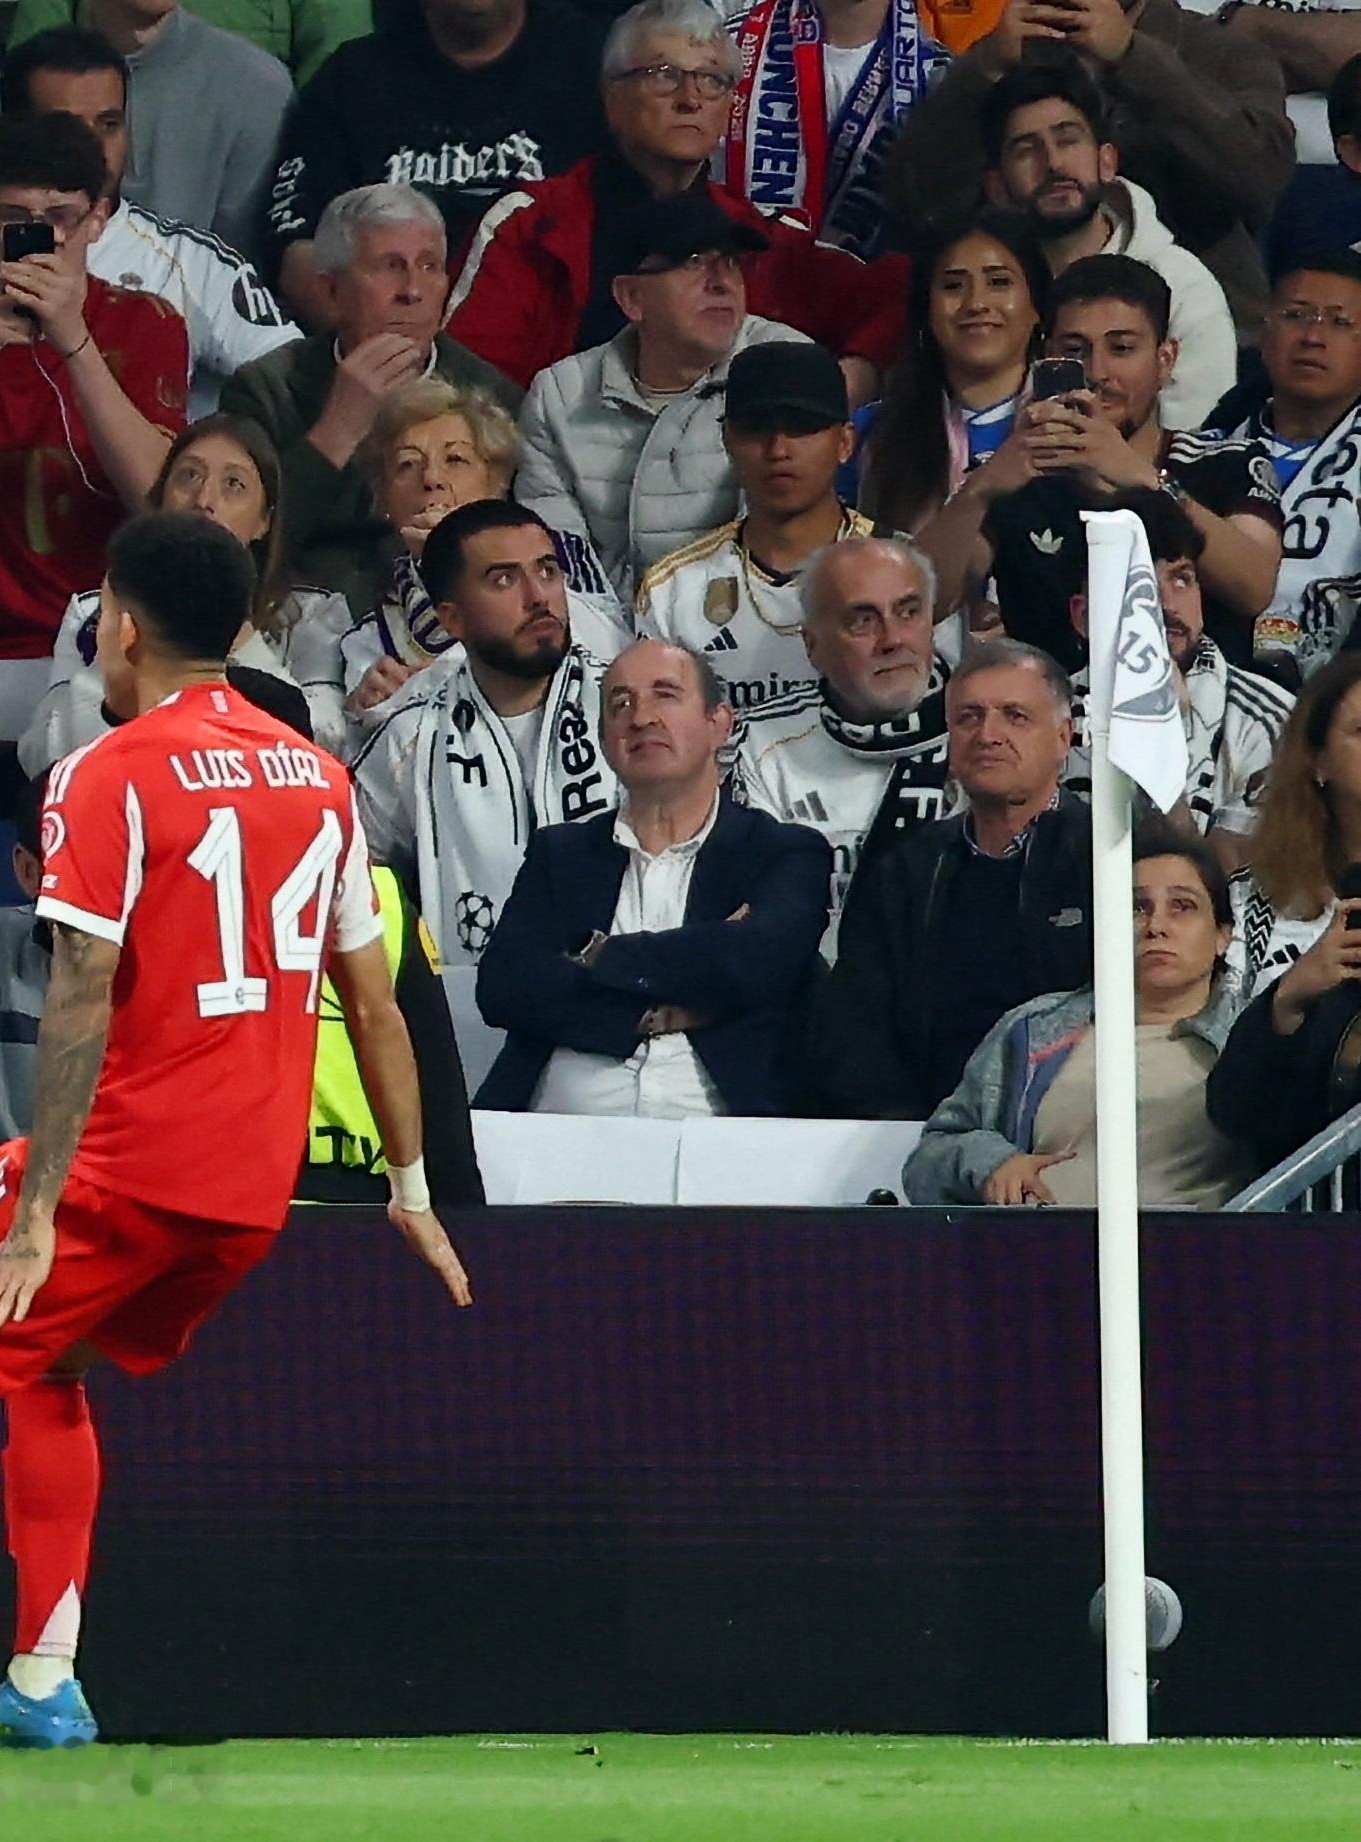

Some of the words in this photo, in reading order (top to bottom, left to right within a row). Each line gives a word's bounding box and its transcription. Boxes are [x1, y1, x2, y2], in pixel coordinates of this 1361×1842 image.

[169, 747, 253, 791] LUIS
[255, 740, 331, 790] DÍAZ
[186, 805, 343, 1019] 14
